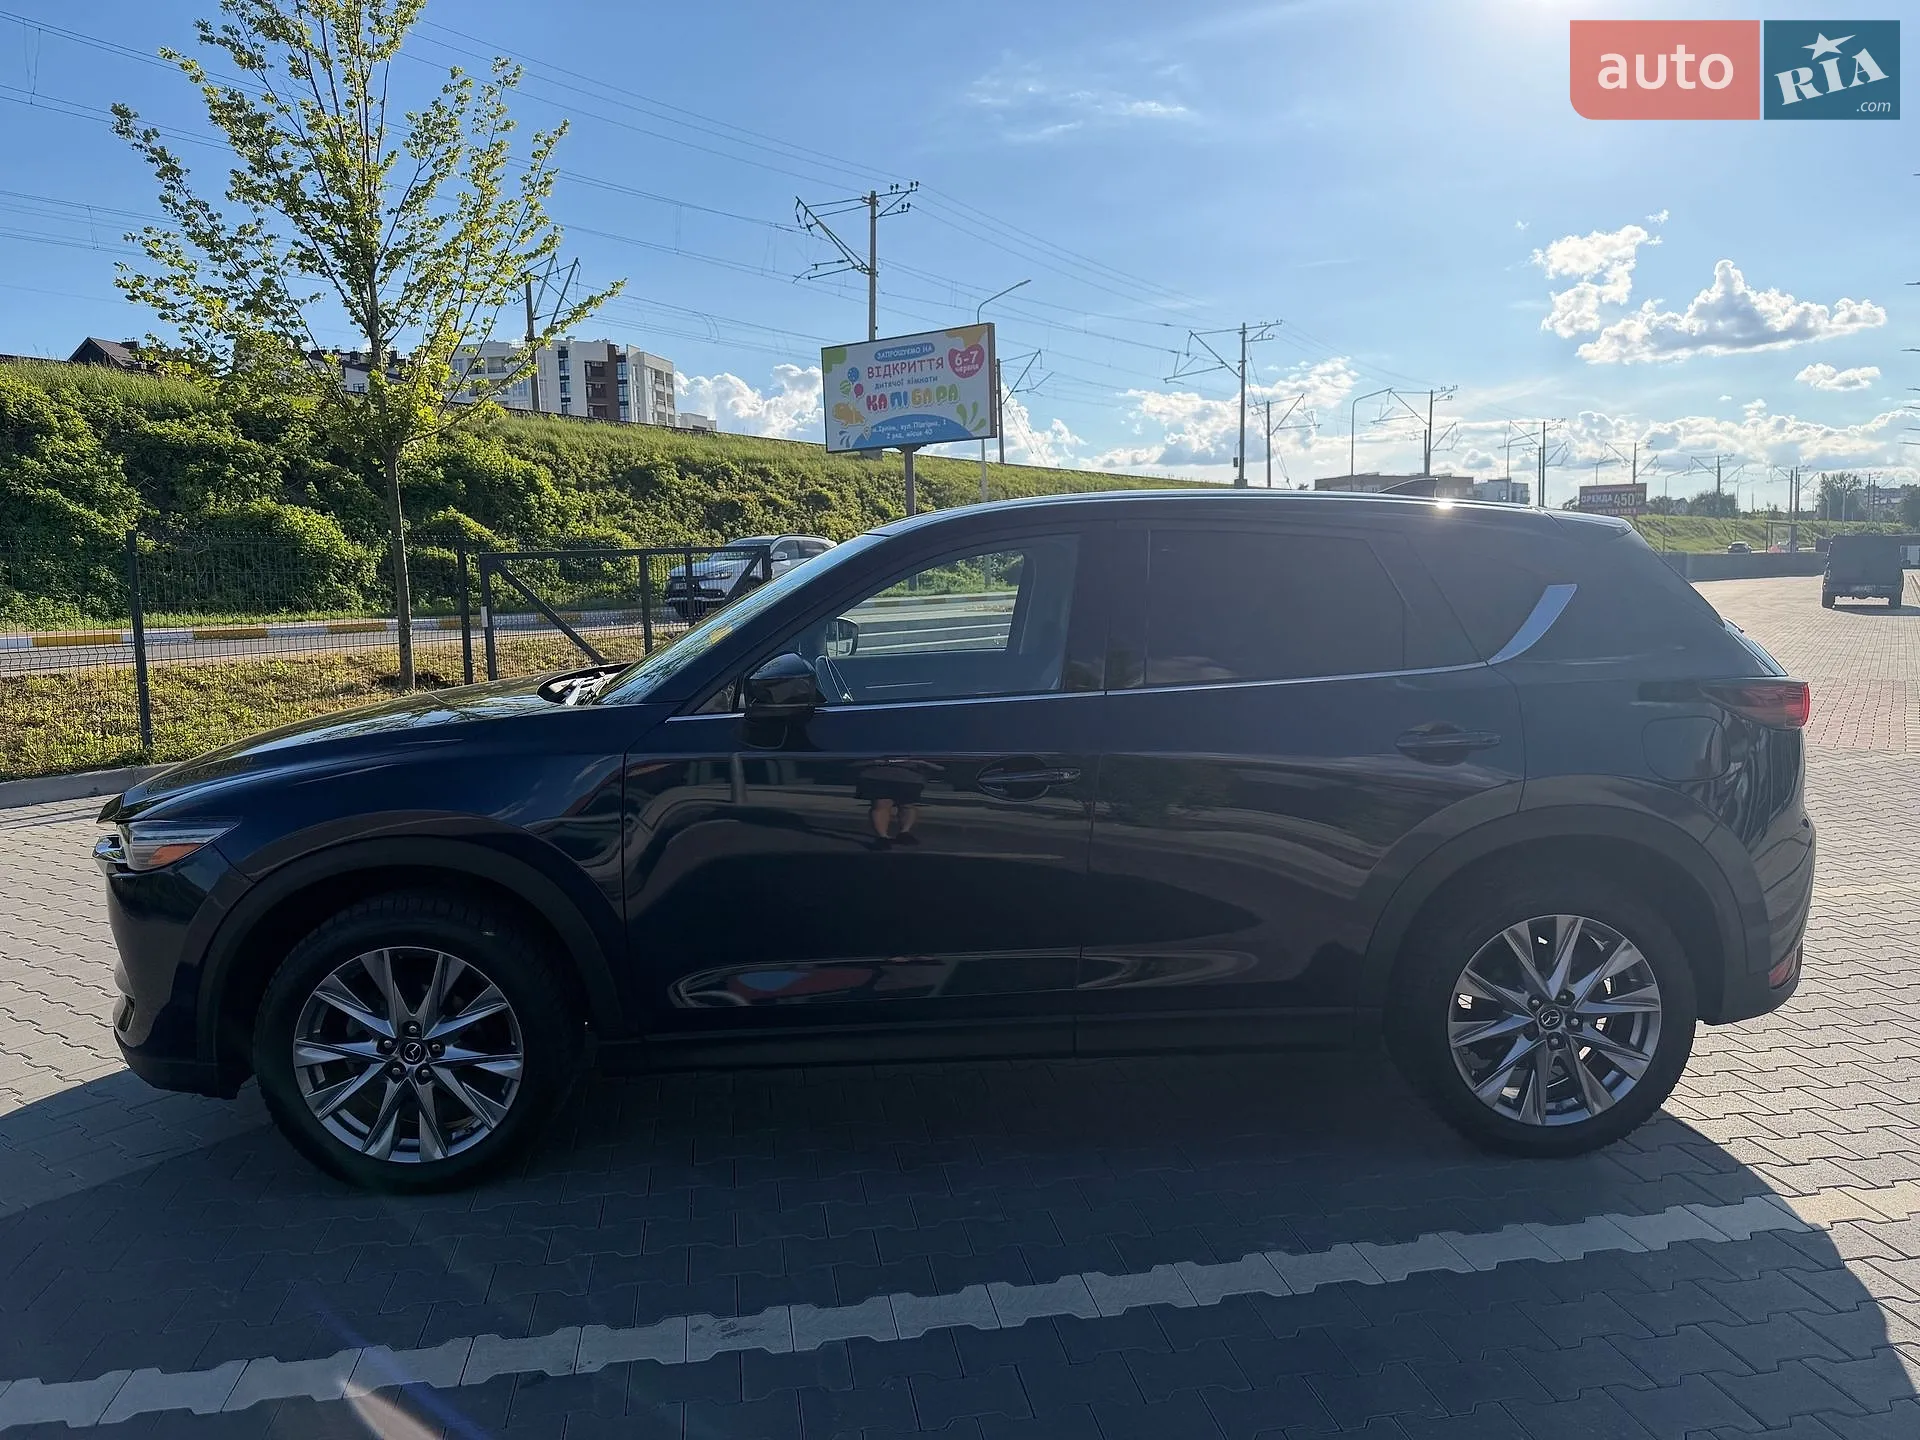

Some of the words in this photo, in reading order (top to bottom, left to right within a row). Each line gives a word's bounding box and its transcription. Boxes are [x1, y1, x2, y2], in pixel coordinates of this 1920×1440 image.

[922, 344, 932, 353] НА
[955, 350, 980, 367] 6-7
[867, 357, 944, 379] ВІДКРИТТЯ
[874, 378, 904, 390] дитячої
[907, 375, 938, 385] кімнати
[866, 383, 959, 411] КАПІБАРА
[1581, 494, 1613, 504] ОРЕНДА
[1613, 492, 1635, 507] 450
